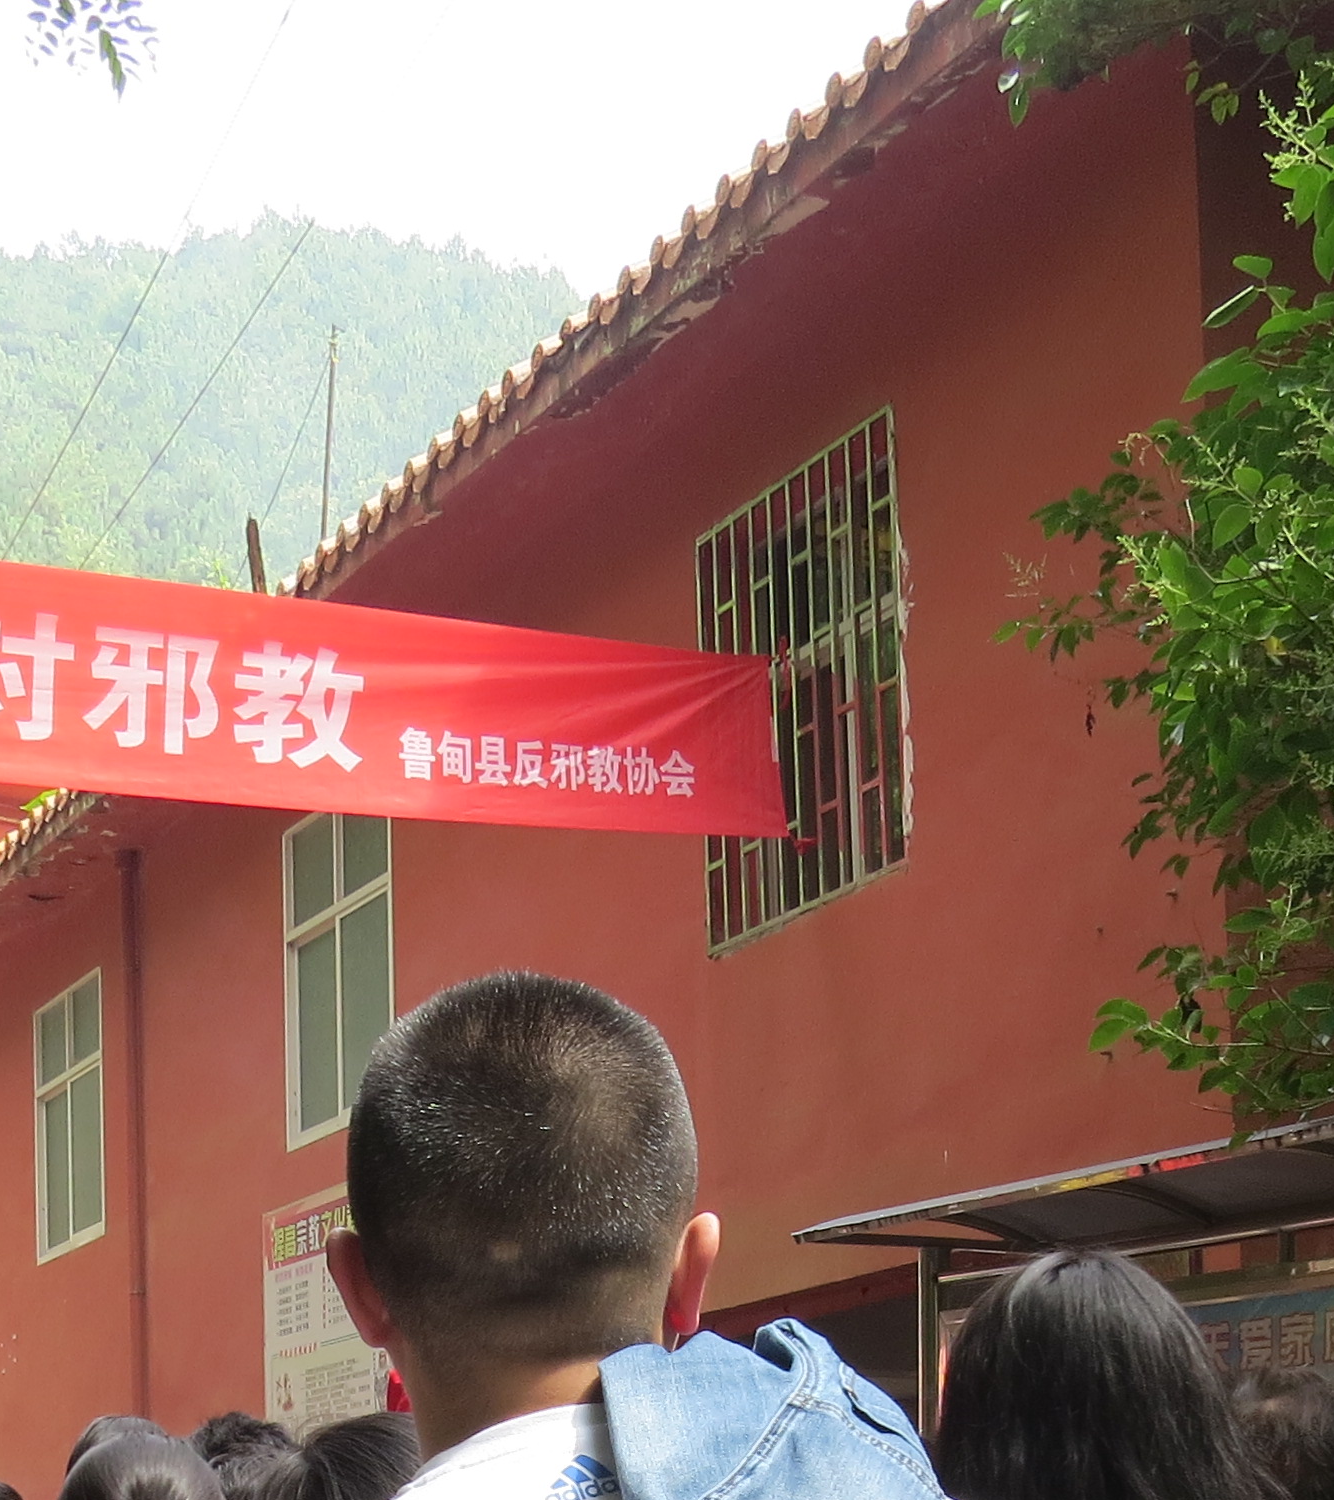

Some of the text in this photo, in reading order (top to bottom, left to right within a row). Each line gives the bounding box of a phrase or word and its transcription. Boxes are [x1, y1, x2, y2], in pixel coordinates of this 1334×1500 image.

[397, 725, 696, 798] 鲁甸县反邪教协会
